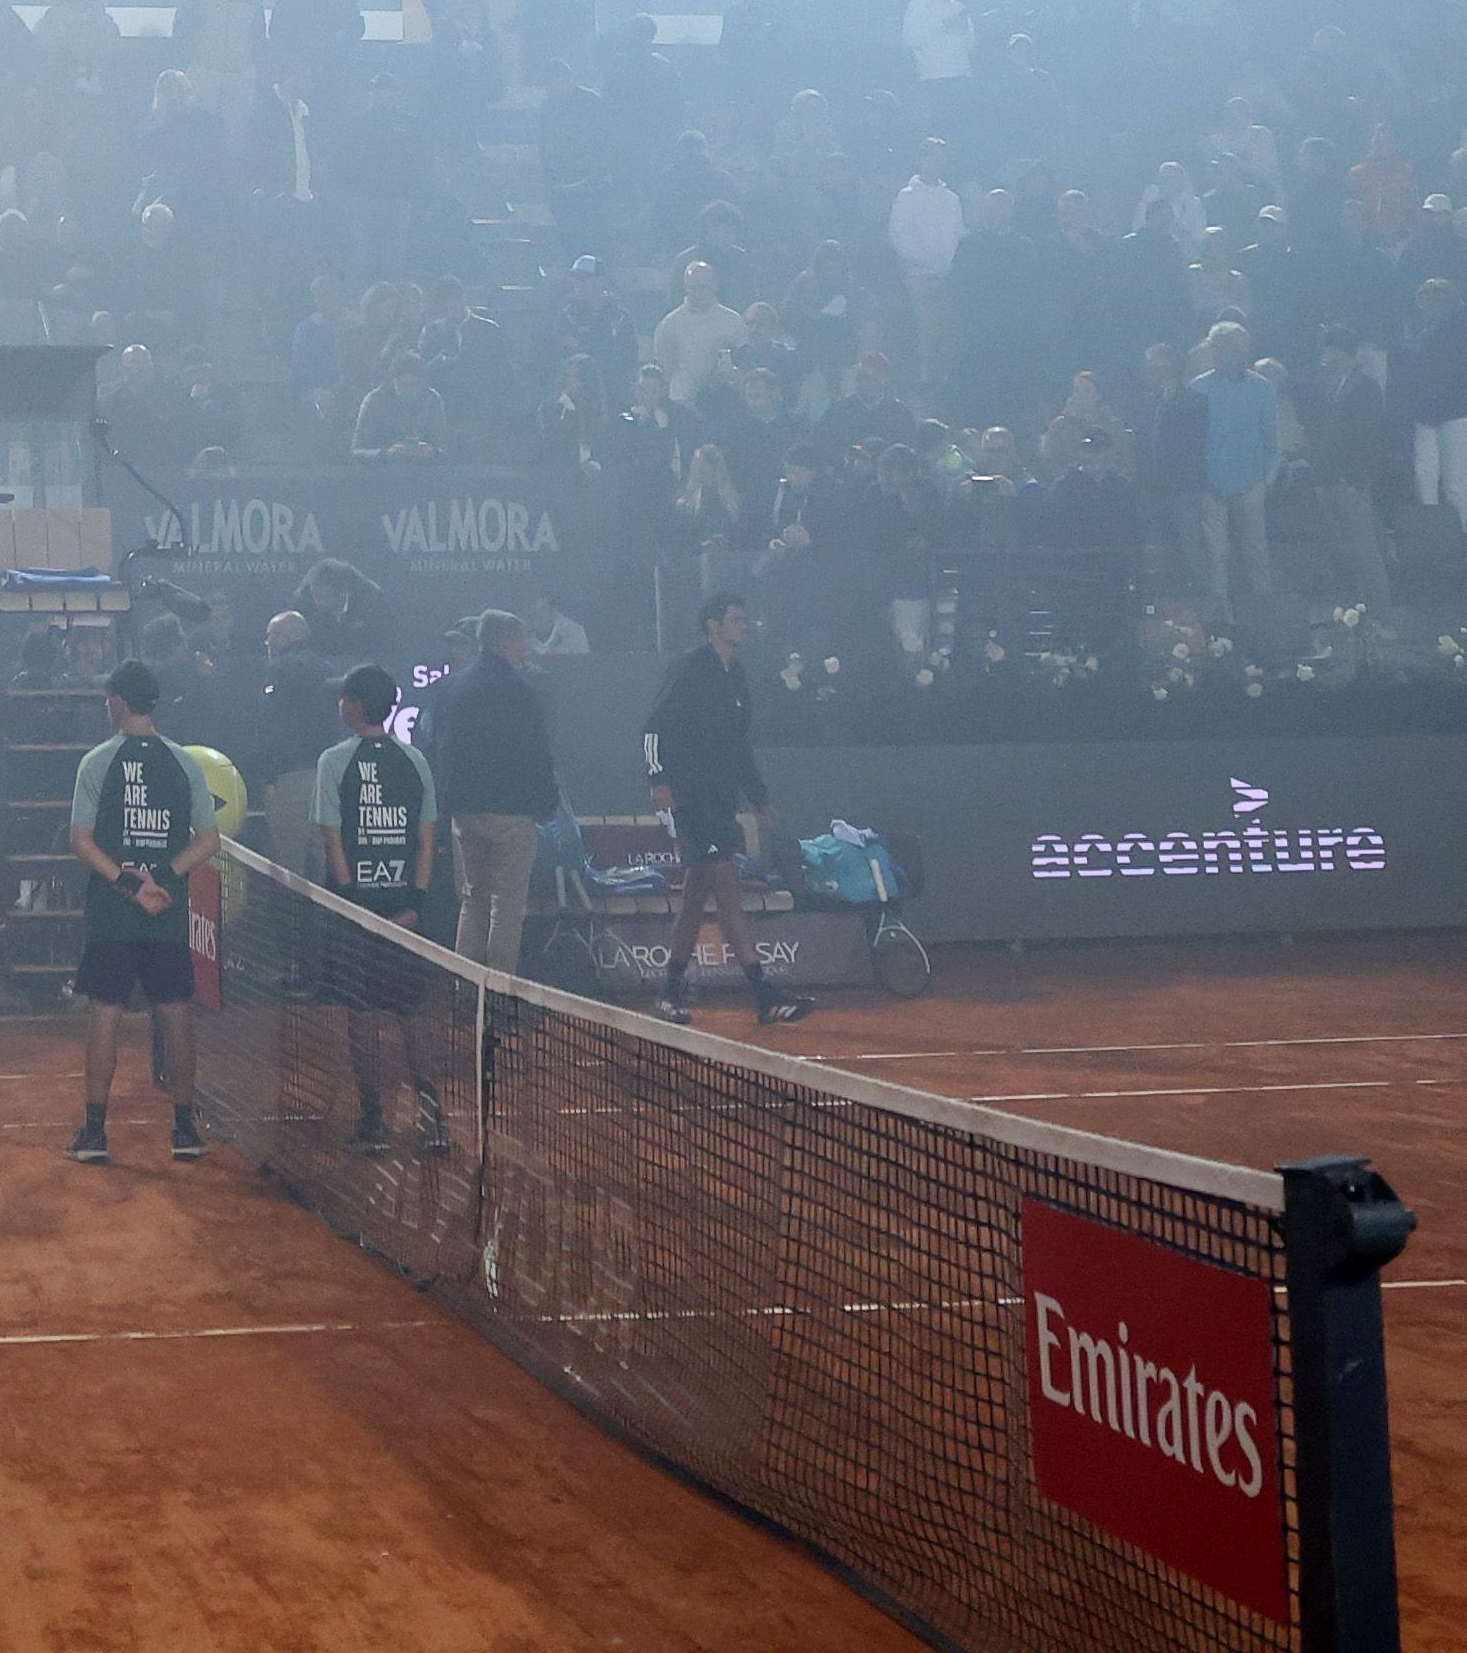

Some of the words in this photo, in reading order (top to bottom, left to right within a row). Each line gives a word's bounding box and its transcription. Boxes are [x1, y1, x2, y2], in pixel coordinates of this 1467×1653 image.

[144, 498, 325, 554] VALMORA
[381, 497, 560, 553] VALMORA
[122, 761, 145, 784] WE
[358, 761, 379, 783] WE
[124, 784, 148, 807] ARE
[359, 784, 383, 805] ARE
[123, 807, 171, 831] TENNIS
[358, 806, 408, 828] TENNIS
[1030, 819, 1386, 878] accenture
[356, 859, 406, 883] EA7
[188, 897, 217, 962] irates
[630, 944, 719, 968] ROHE
[1034, 1290, 1264, 1499] Emirates
